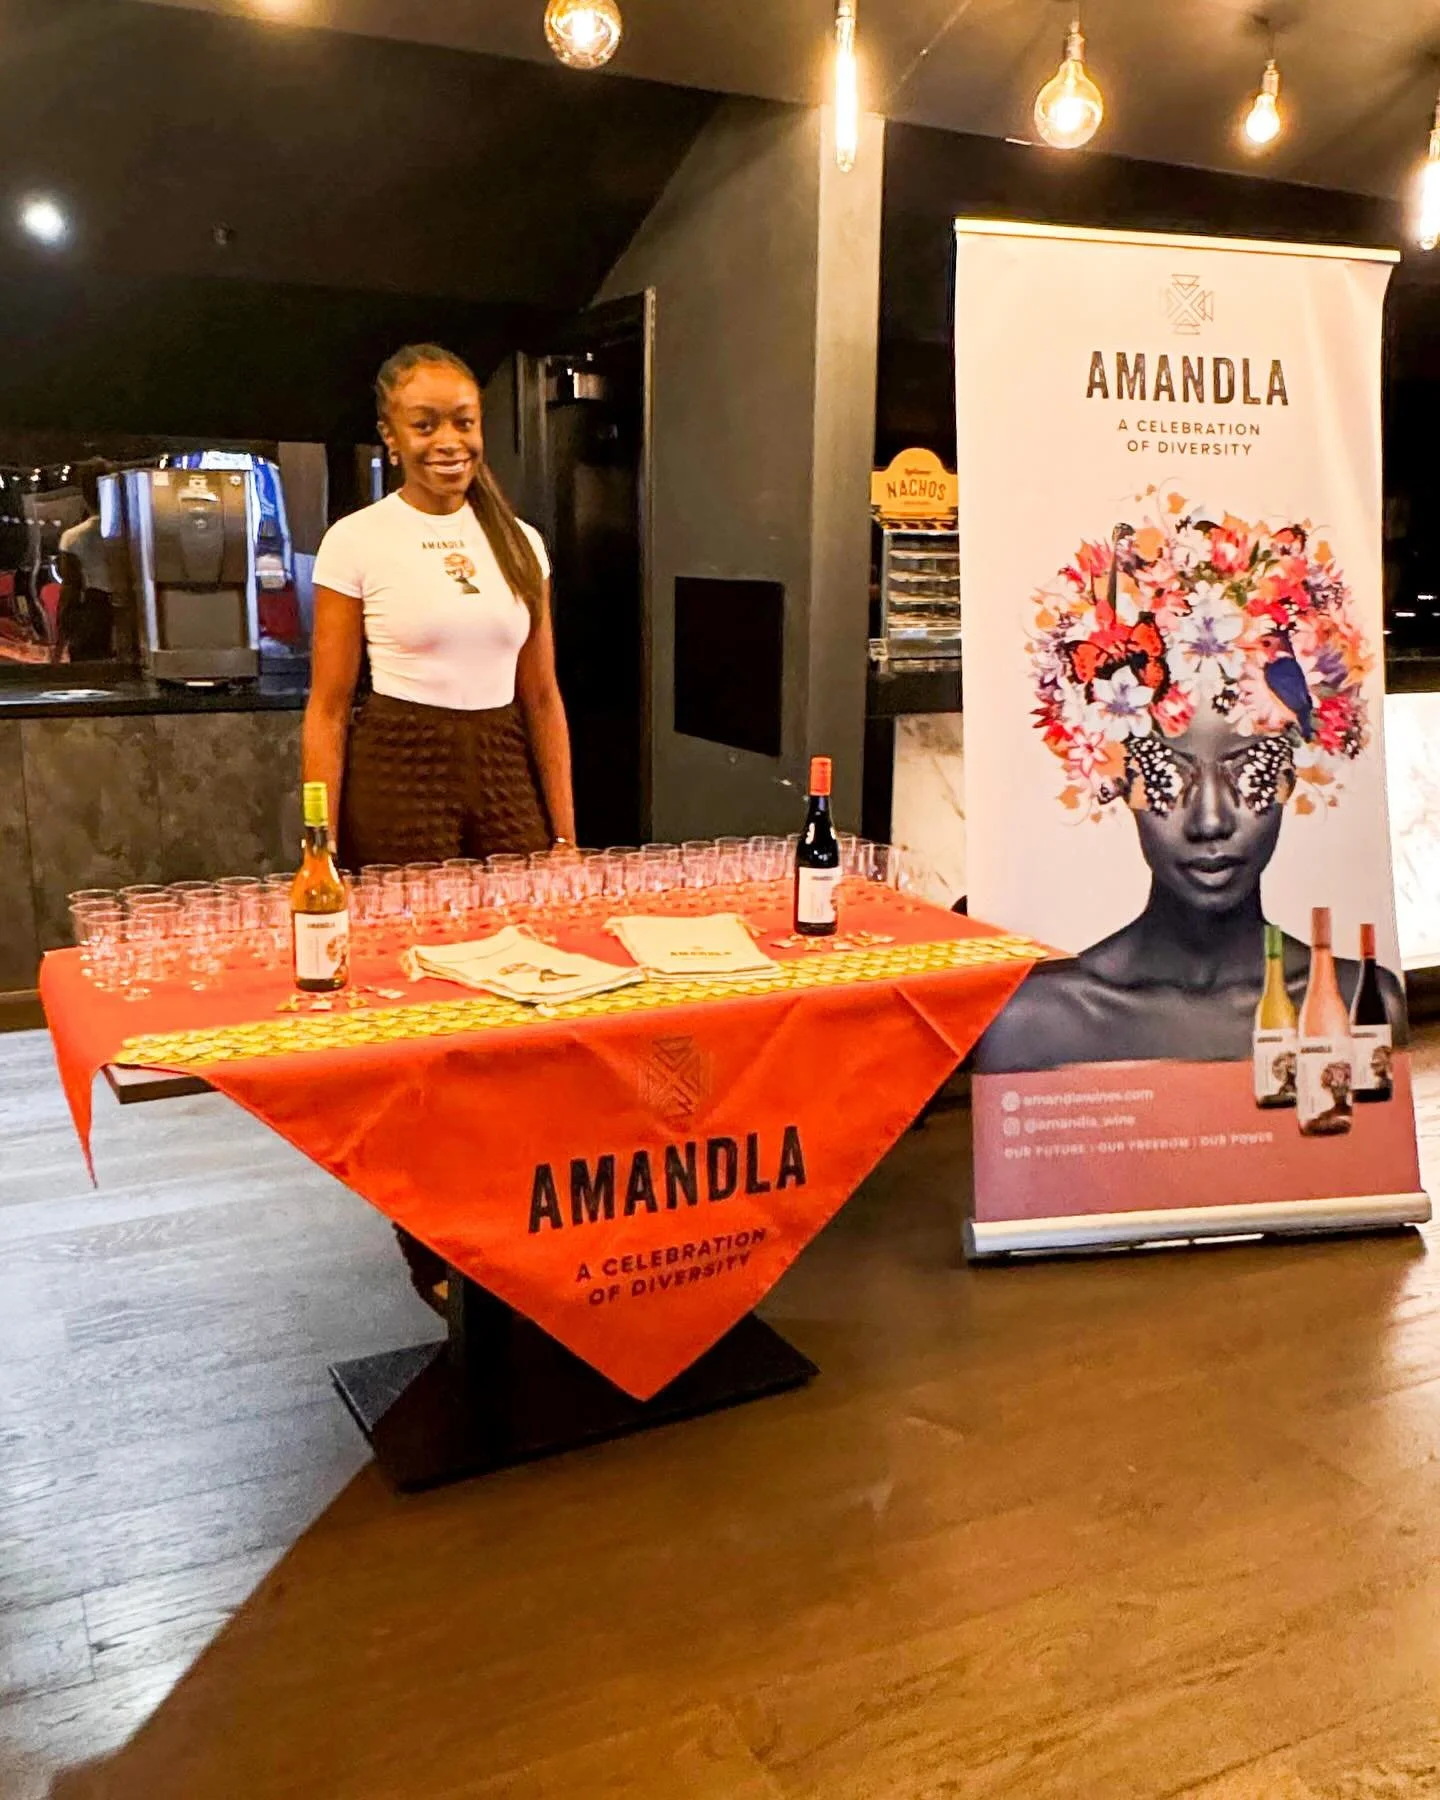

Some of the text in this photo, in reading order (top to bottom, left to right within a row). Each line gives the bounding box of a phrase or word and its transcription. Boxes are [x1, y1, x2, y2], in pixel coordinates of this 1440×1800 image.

[1086, 351, 1288, 406] AMANDLA
[1118, 419, 1260, 435] A CELEBRATION
[1127, 440, 1252, 455] OF DIVERSITY
[887, 479, 946, 500] NACHOS
[1004, 1145, 1031, 1159] OUR
[1201, 1134, 1227, 1146] OUR
[528, 1125, 806, 1233] AMANDLA
[576, 1228, 767, 1282] A CELEBRATION
[589, 1253, 751, 1305] OF DIVERSITY
